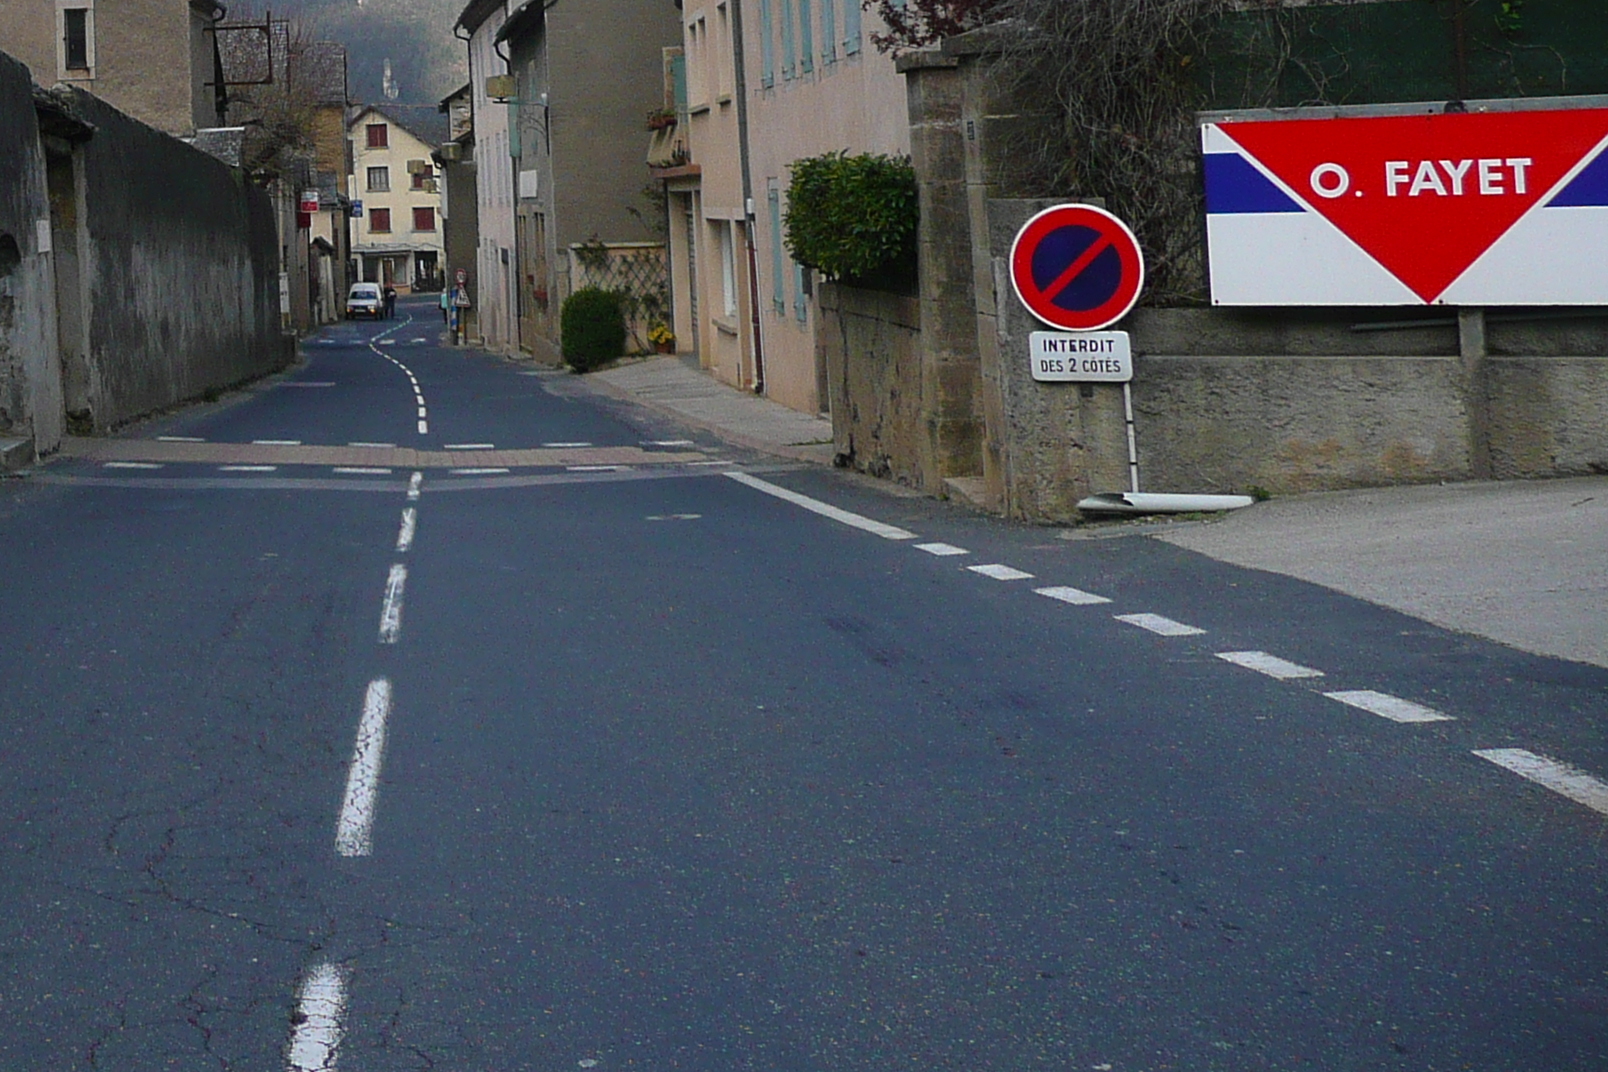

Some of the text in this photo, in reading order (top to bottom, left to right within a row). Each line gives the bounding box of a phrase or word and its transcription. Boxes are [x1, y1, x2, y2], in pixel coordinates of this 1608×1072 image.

[1310, 157, 1533, 199] O. FAYET
[1043, 339, 1115, 353] INTERDIT
[1040, 356, 1121, 373] DES 2 CÔTÉS
